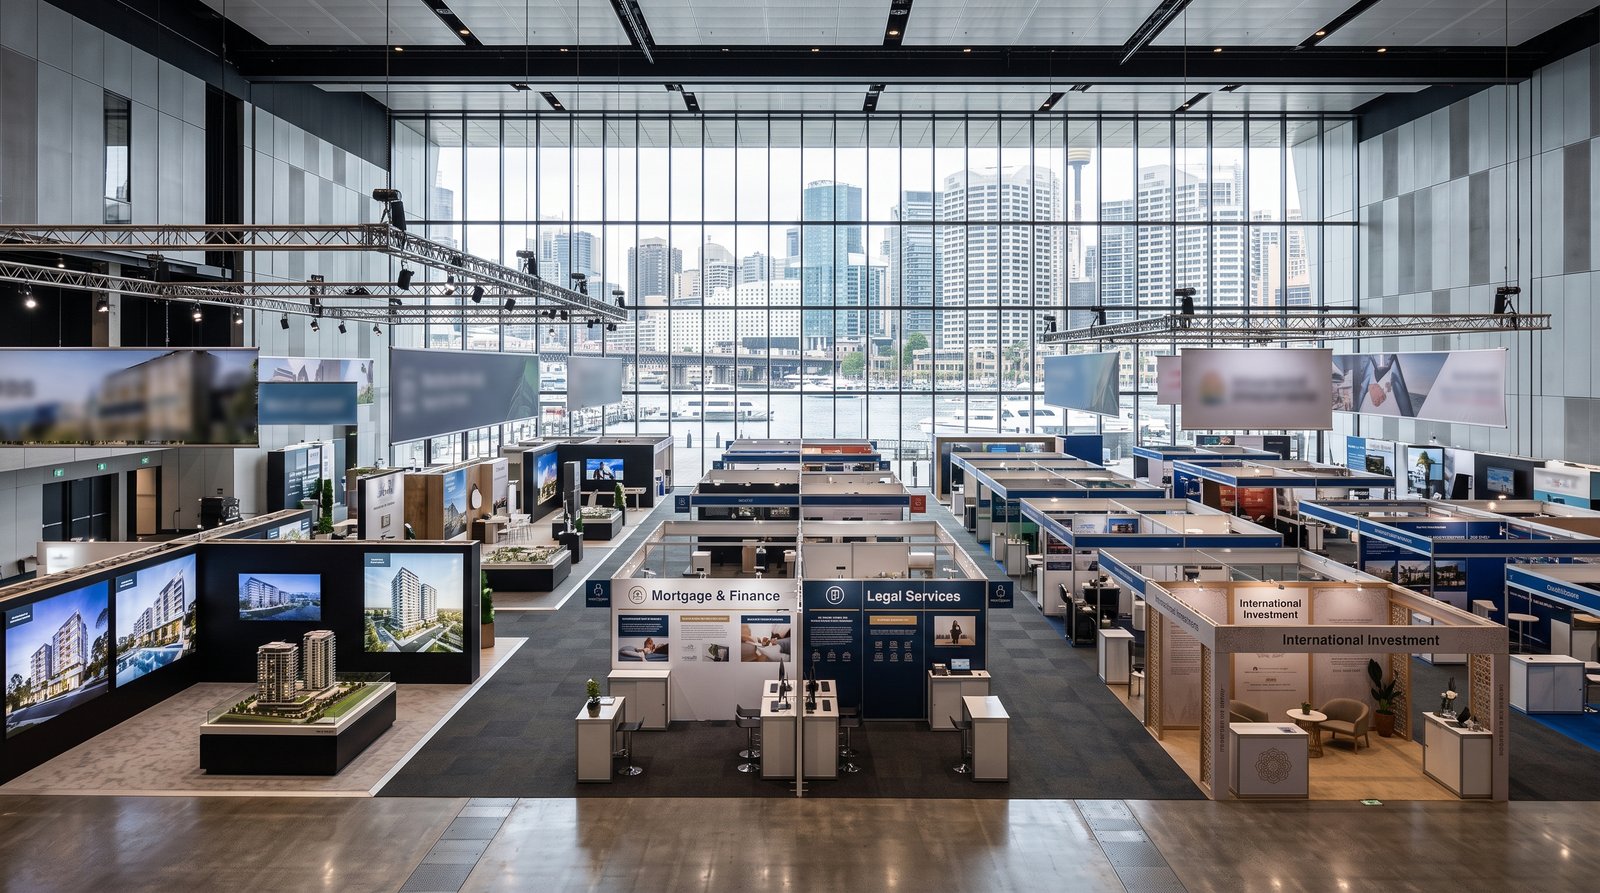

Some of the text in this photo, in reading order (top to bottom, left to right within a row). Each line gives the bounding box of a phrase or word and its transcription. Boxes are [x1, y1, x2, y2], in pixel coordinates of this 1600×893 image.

[652, 589, 781, 604] Mortgage & Finance
[867, 590, 961, 604] Legal Services
[1239, 599, 1302, 608] International
[1243, 610, 1299, 619] Investment
[1283, 634, 1440, 646] International Investment
